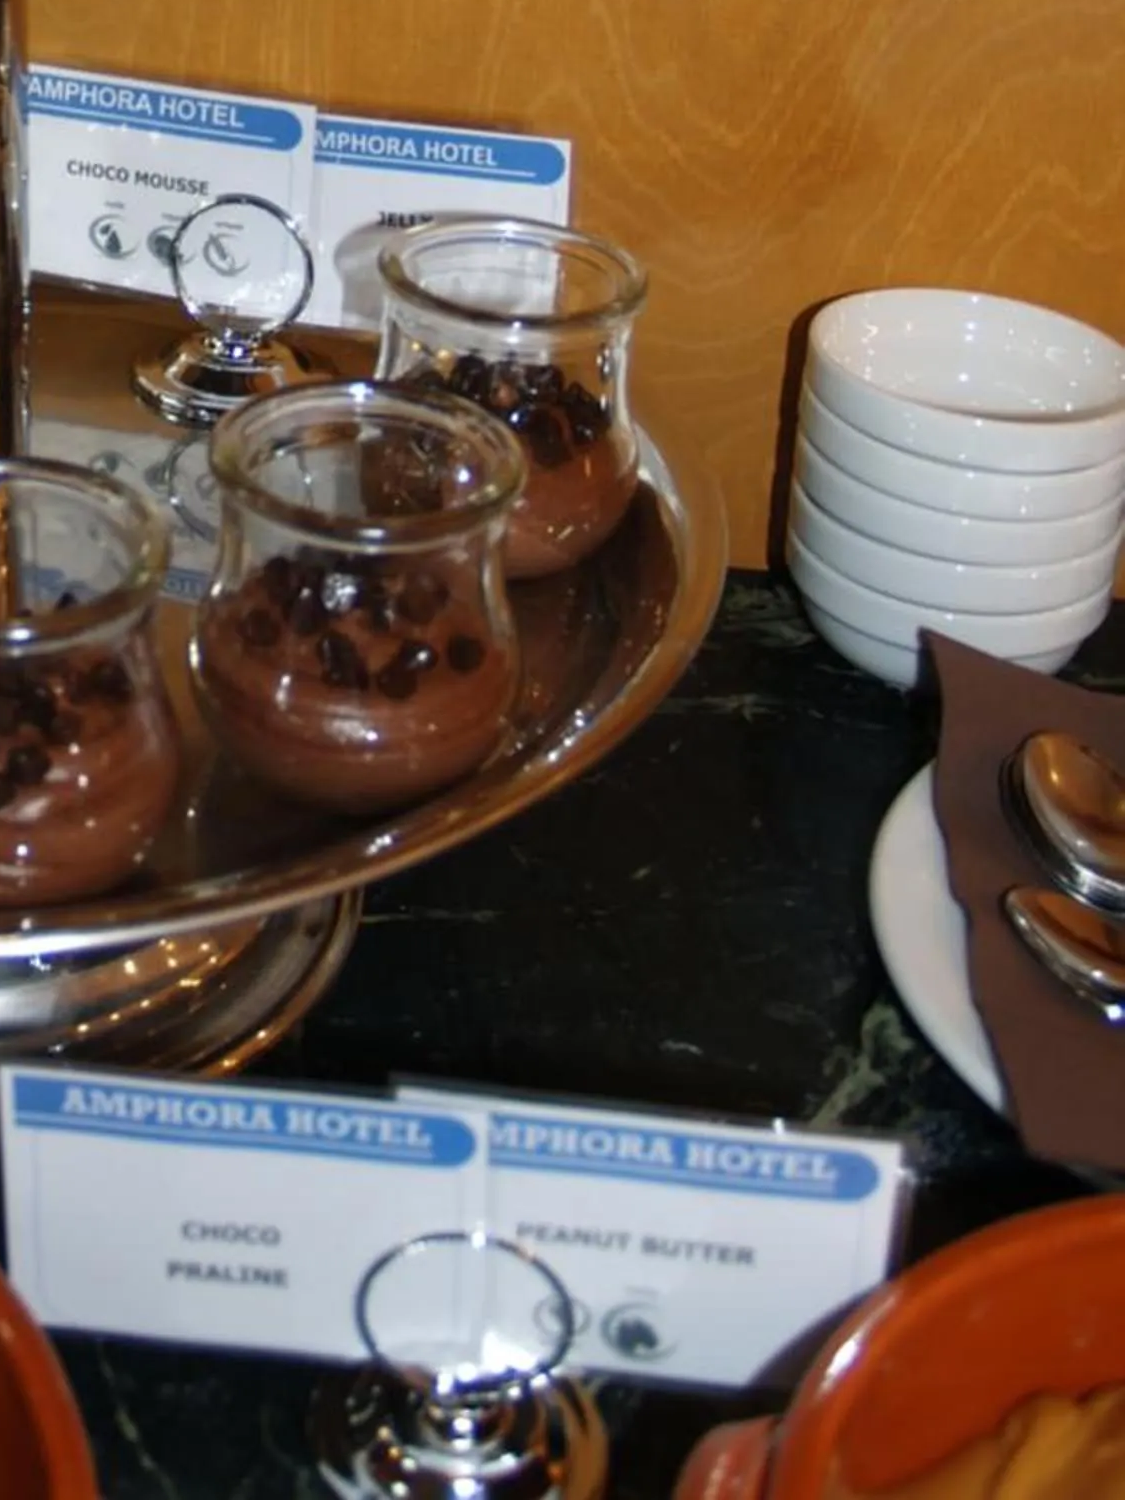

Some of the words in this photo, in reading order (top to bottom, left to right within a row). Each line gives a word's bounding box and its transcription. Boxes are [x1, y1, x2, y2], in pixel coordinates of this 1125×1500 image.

[28, 76, 152, 116] AMPHORA
[159, 97, 245, 128] HOTEL
[315, 129, 418, 158] MPHORA
[424, 140, 497, 167] HOTEL
[67, 160, 129, 183] CHOCO
[134, 170, 211, 196] MOUSSE
[60, 1086, 275, 1134] AMPHORA
[286, 1108, 433, 1148] HOTEL
[489, 1122, 674, 1166] MPHORA
[687, 1141, 839, 1181] HOTEL
[181, 1220, 282, 1247] CHOCO
[515, 1221, 631, 1250] PEANUT
[640, 1234, 757, 1267] BUTTER
[167, 1260, 289, 1288] PRALINE
